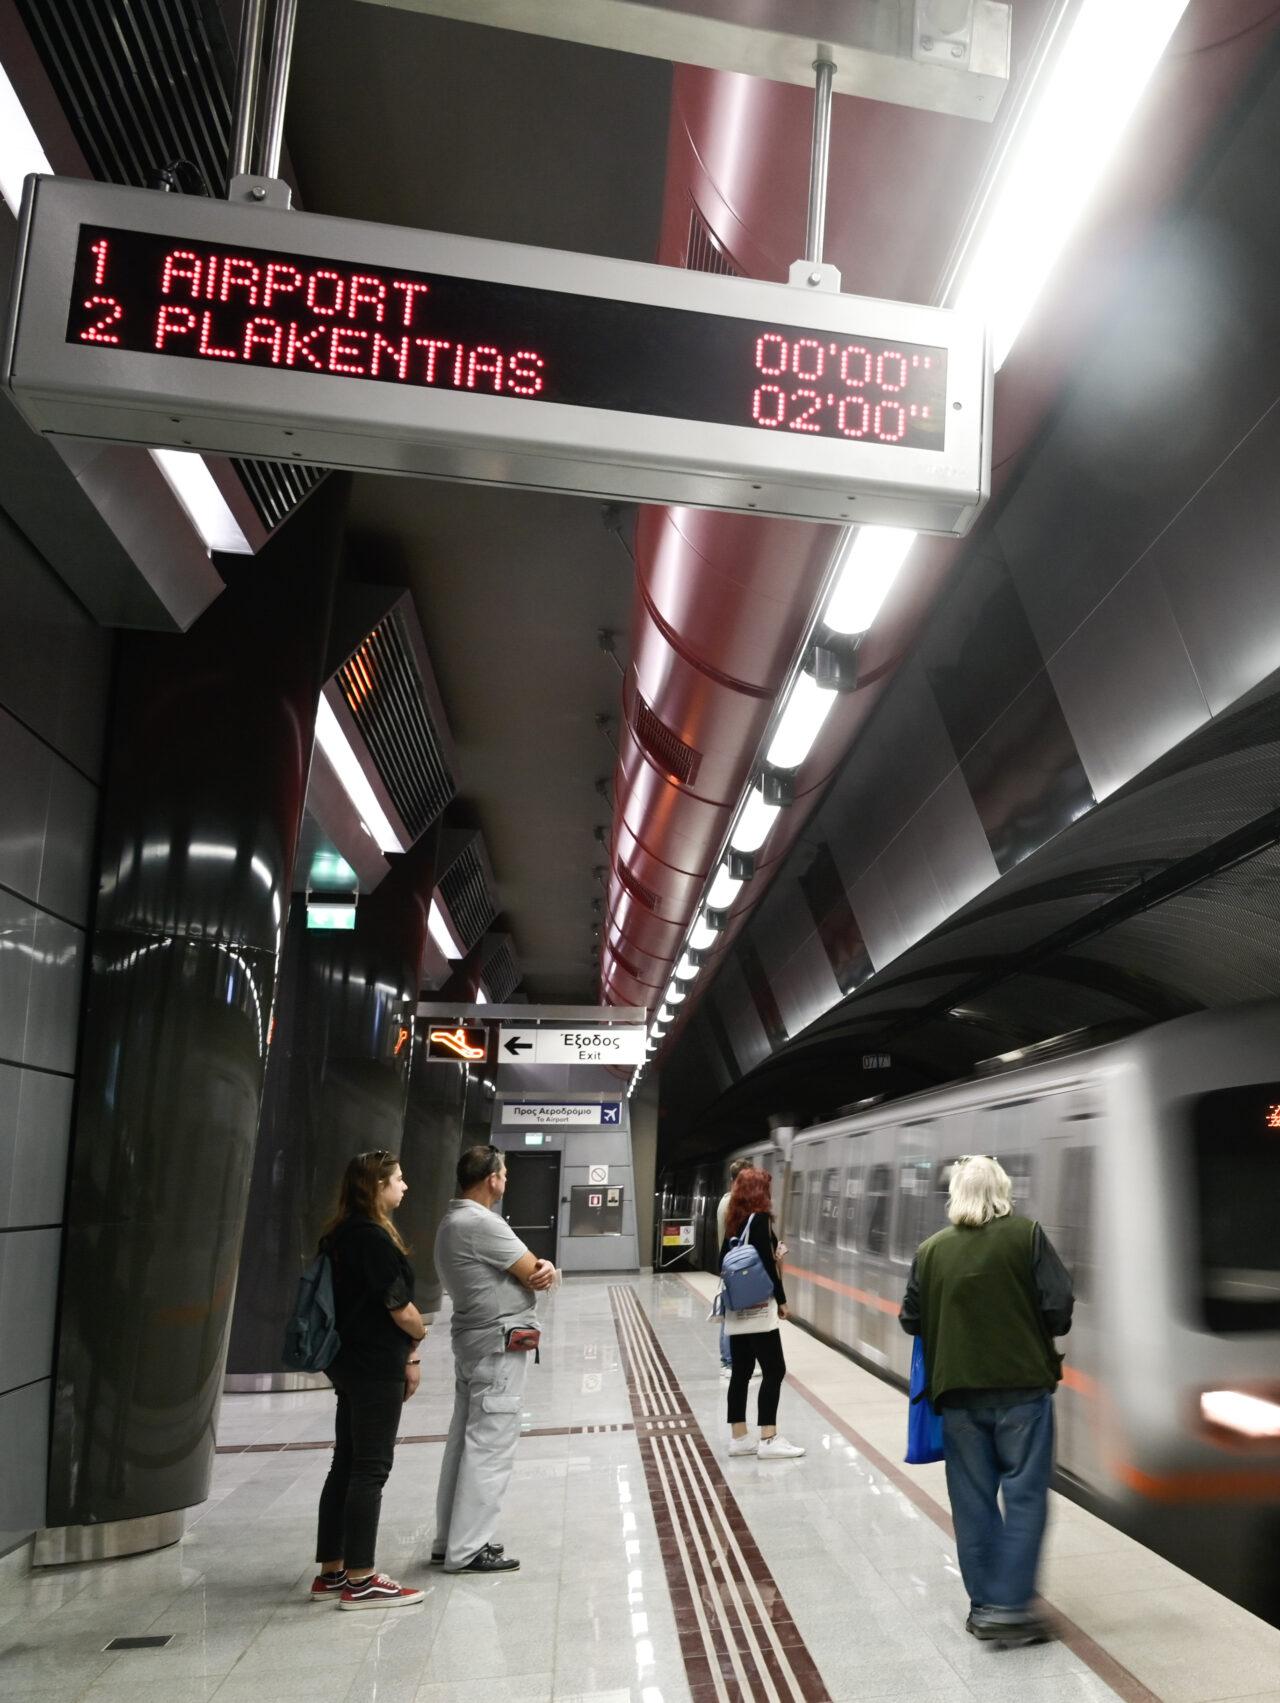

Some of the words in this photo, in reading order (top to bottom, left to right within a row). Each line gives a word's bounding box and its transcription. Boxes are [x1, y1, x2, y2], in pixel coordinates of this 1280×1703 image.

[90, 240, 107, 286] 1
[160, 250, 430, 327] AIRPORT
[80, 296, 122, 343] 2
[155, 305, 545, 395] PLAKENTIAS
[579, 1051, 601, 1060] Exit
[514, 1107, 537, 1116] Προς
[539, 1107, 592, 1116] Αεροδρόμιο
